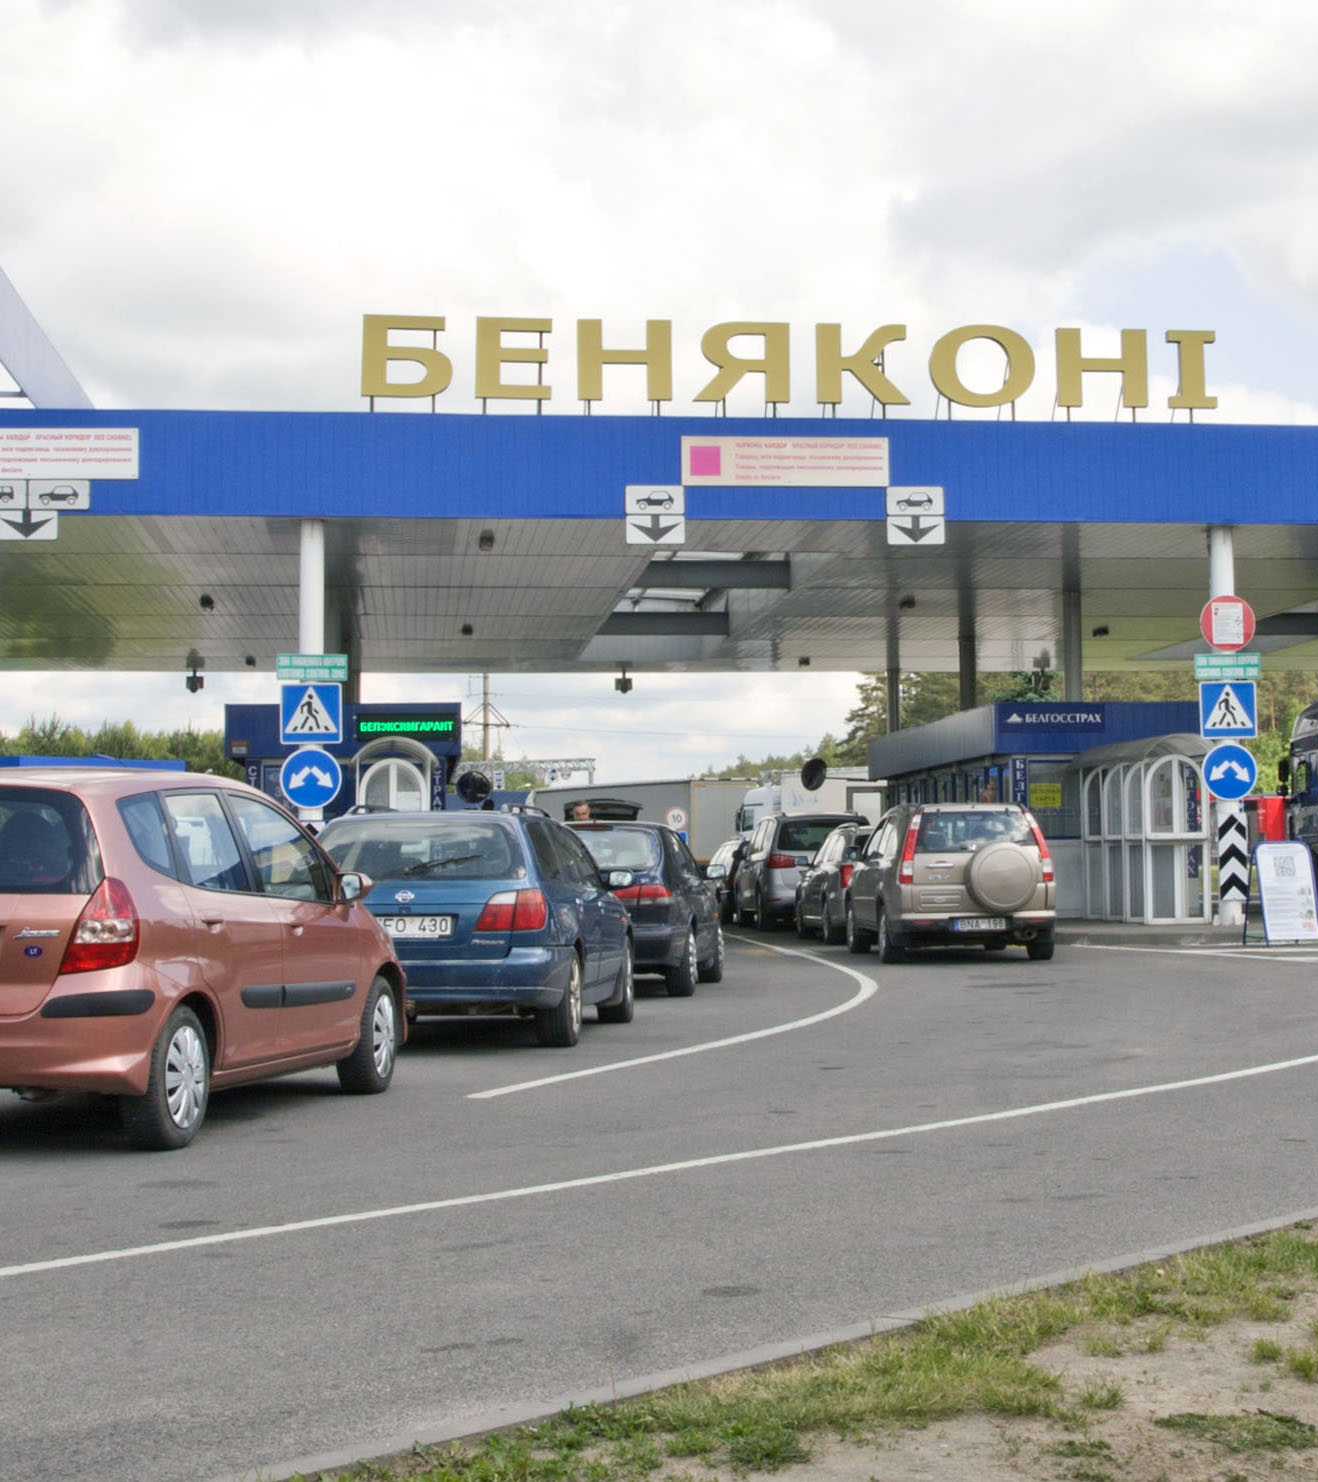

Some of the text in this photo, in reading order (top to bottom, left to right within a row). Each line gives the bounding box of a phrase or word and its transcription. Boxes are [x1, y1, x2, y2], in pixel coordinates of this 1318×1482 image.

[361, 314, 1219, 409] БЕНЯКОНІ
[1025, 713, 1102, 723] БЕЛГОССТРАХ
[672, 814, 682, 823] 10
[379, 918, 449, 933] FO 430
